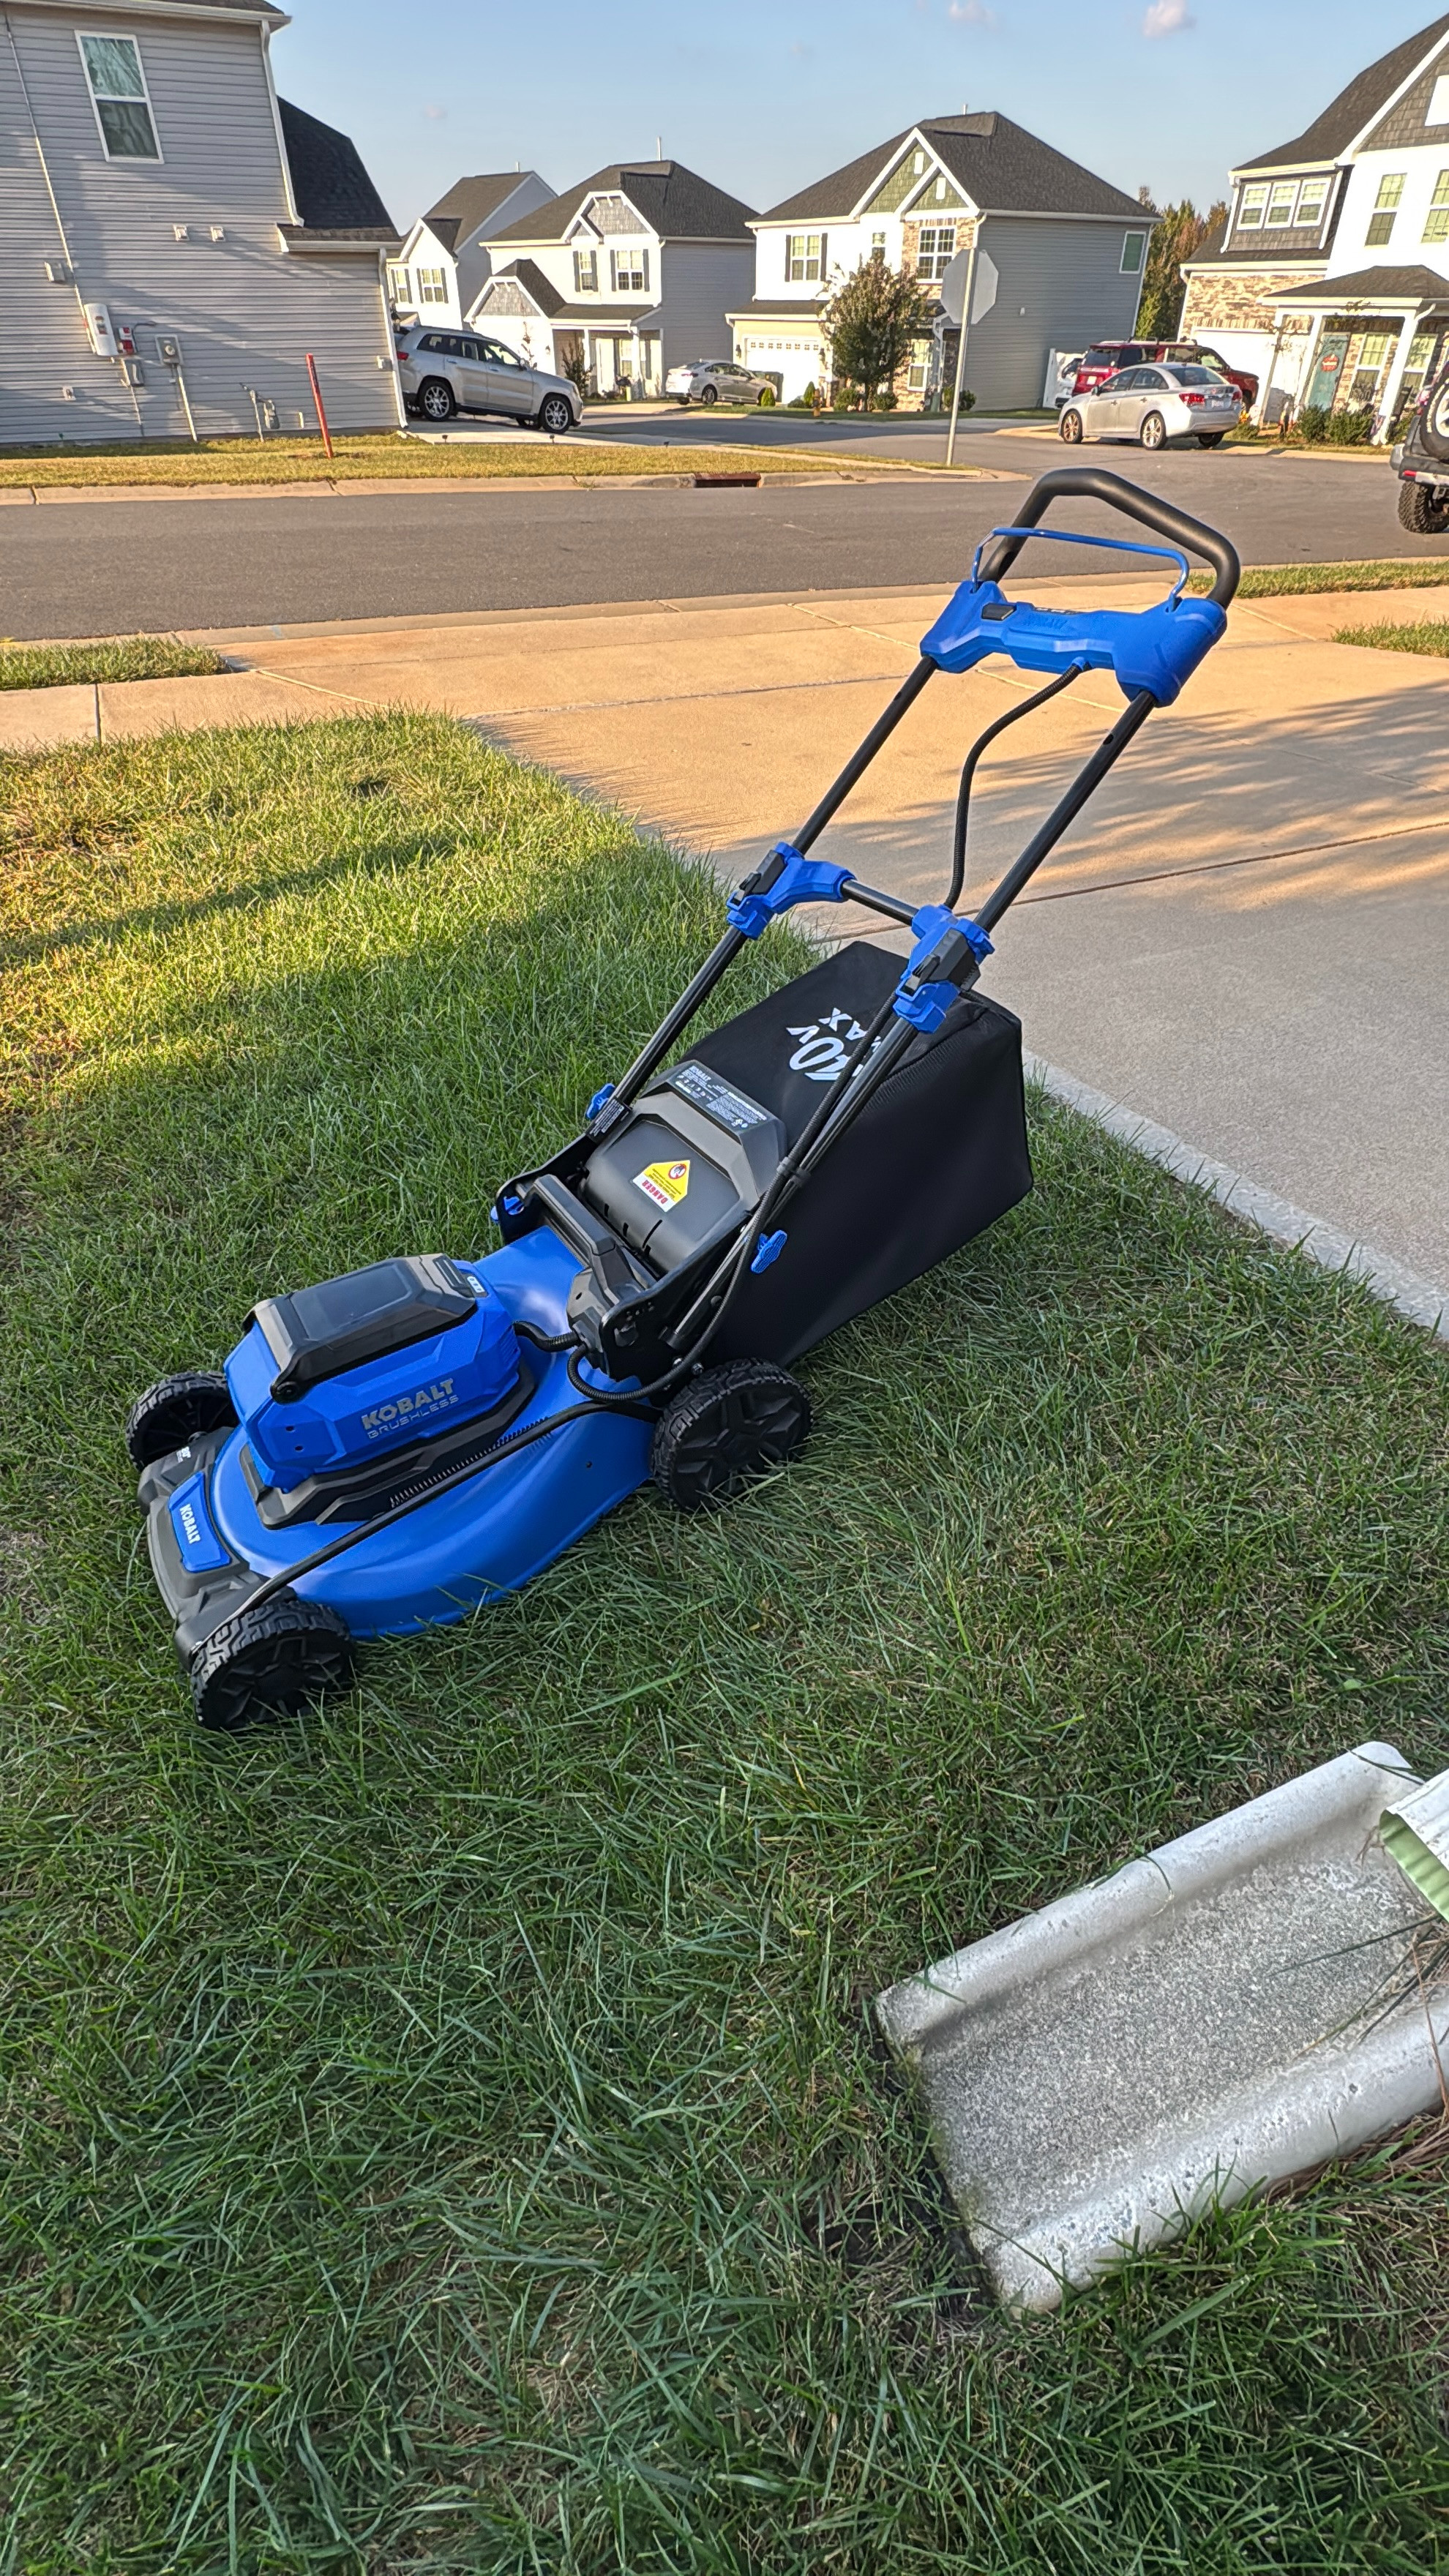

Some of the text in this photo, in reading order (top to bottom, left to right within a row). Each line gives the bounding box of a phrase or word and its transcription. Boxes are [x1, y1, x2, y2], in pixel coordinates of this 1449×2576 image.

[641, 1179, 668, 1205] DANGER
[361, 1377, 454, 1431] KOBALT
[367, 1395, 460, 1439] BRUSHLESS
[179, 1503, 201, 1545] KOBALT
